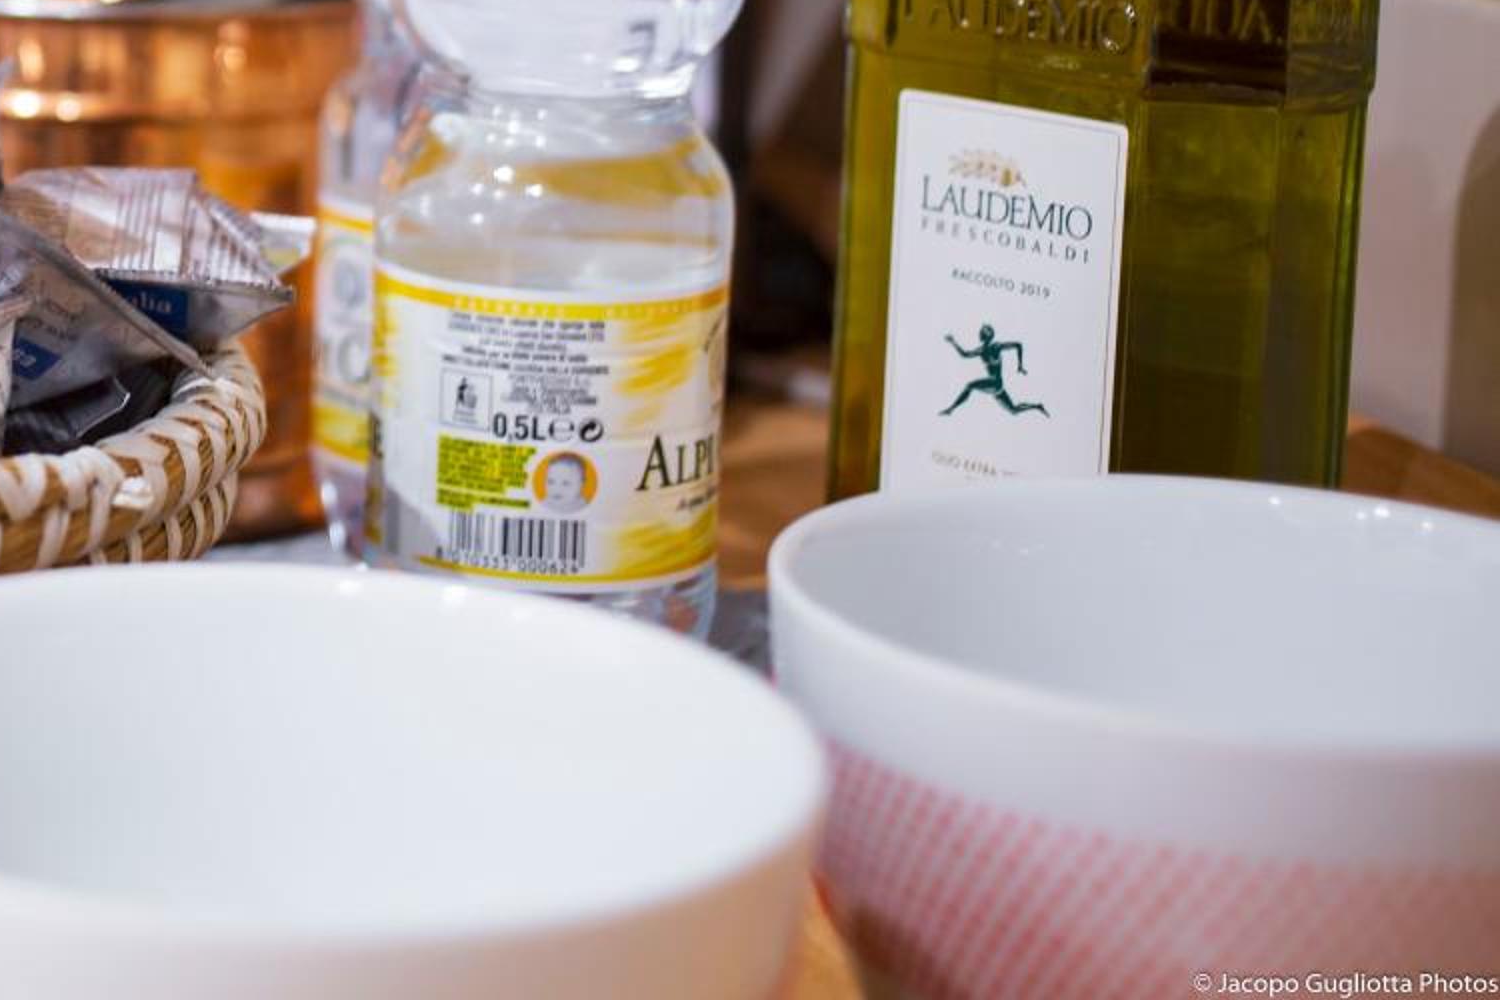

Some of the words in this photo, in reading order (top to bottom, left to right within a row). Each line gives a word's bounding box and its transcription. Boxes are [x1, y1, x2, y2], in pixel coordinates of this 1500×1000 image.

[921, 173, 1094, 241] LAUDEMIO
[920, 215, 1091, 265] FRESCOBALDI
[951, 268, 1015, 292] RACCOLTO
[1019, 279, 1051, 299] 2019
[493, 411, 546, 443] 0,5L
